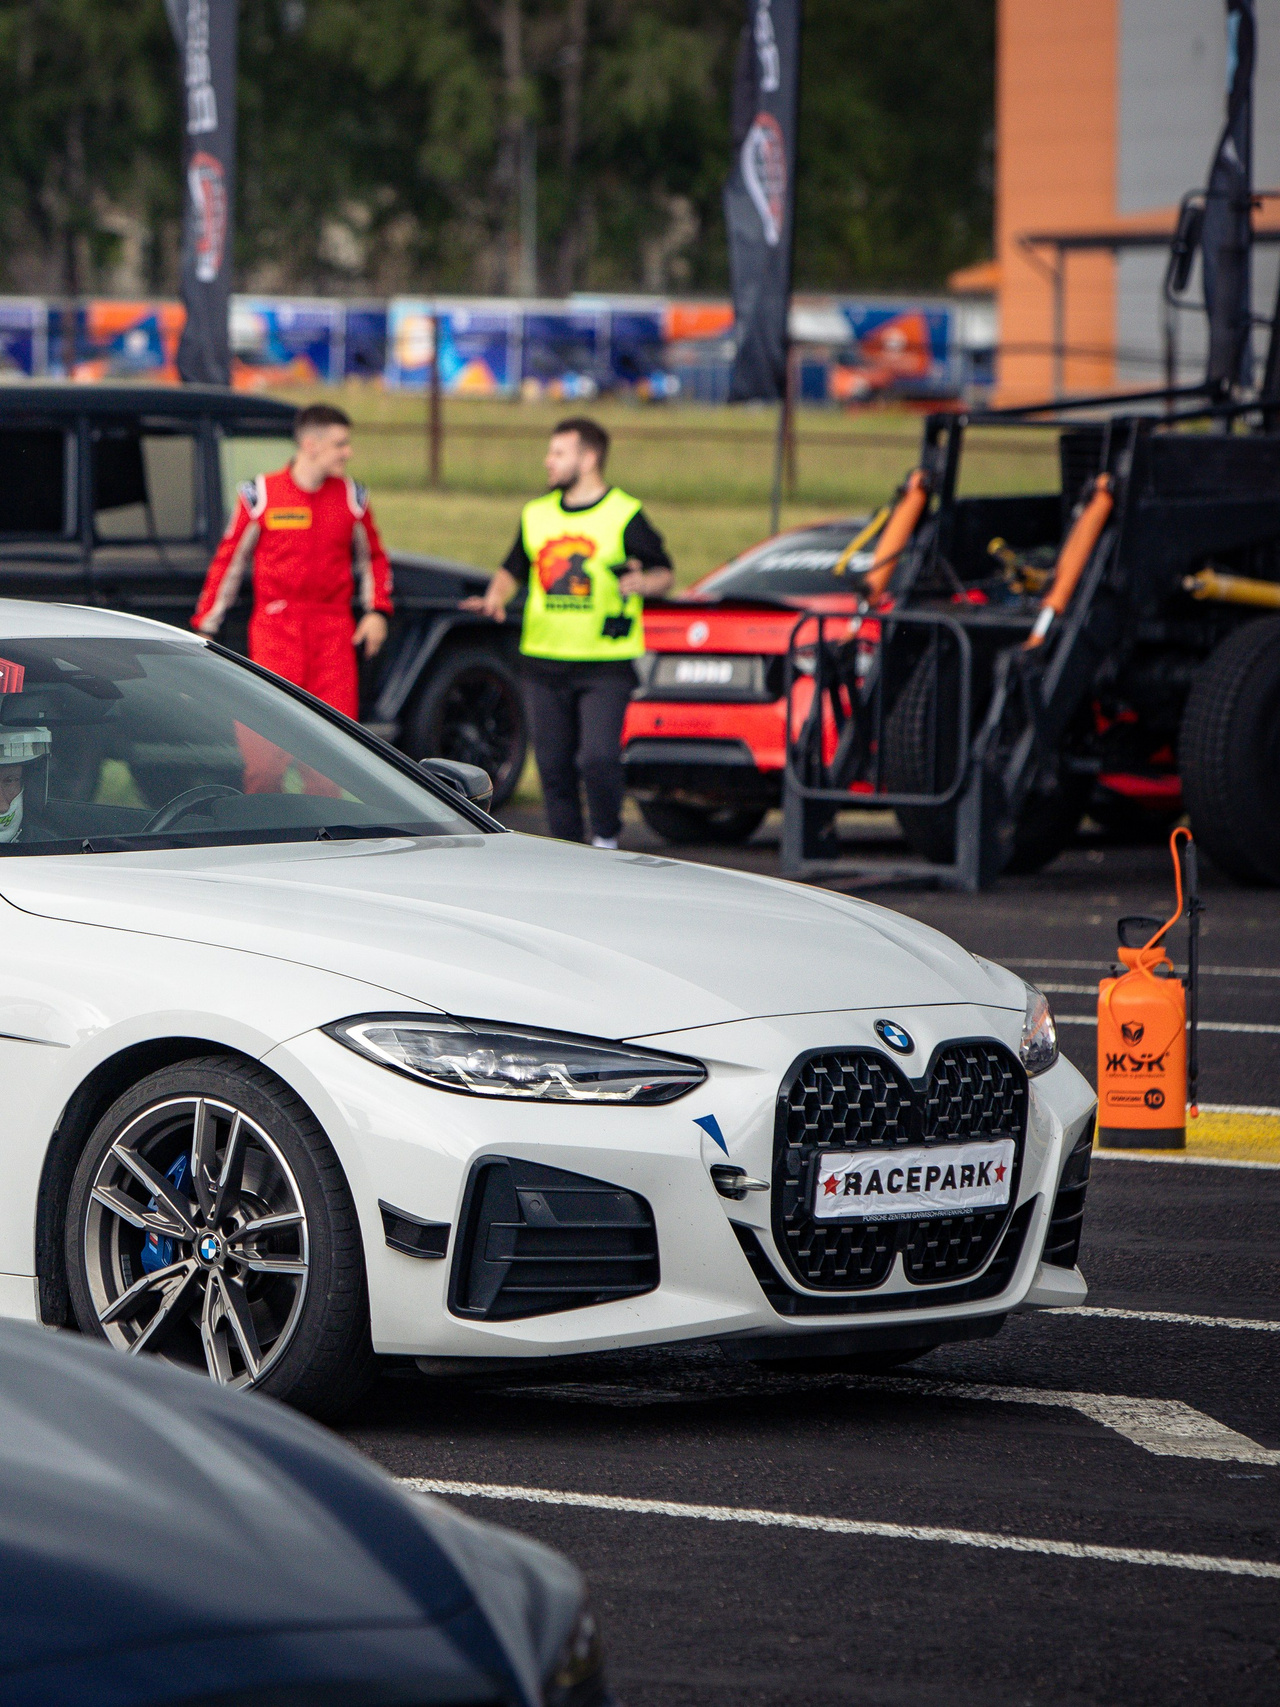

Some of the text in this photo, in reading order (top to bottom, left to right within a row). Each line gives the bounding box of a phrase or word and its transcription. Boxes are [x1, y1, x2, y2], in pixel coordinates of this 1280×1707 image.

[1105, 1053, 1165, 1072] ЖУК
[1147, 1093, 1163, 1105] 10
[843, 1160, 994, 1197] RACEPARK
